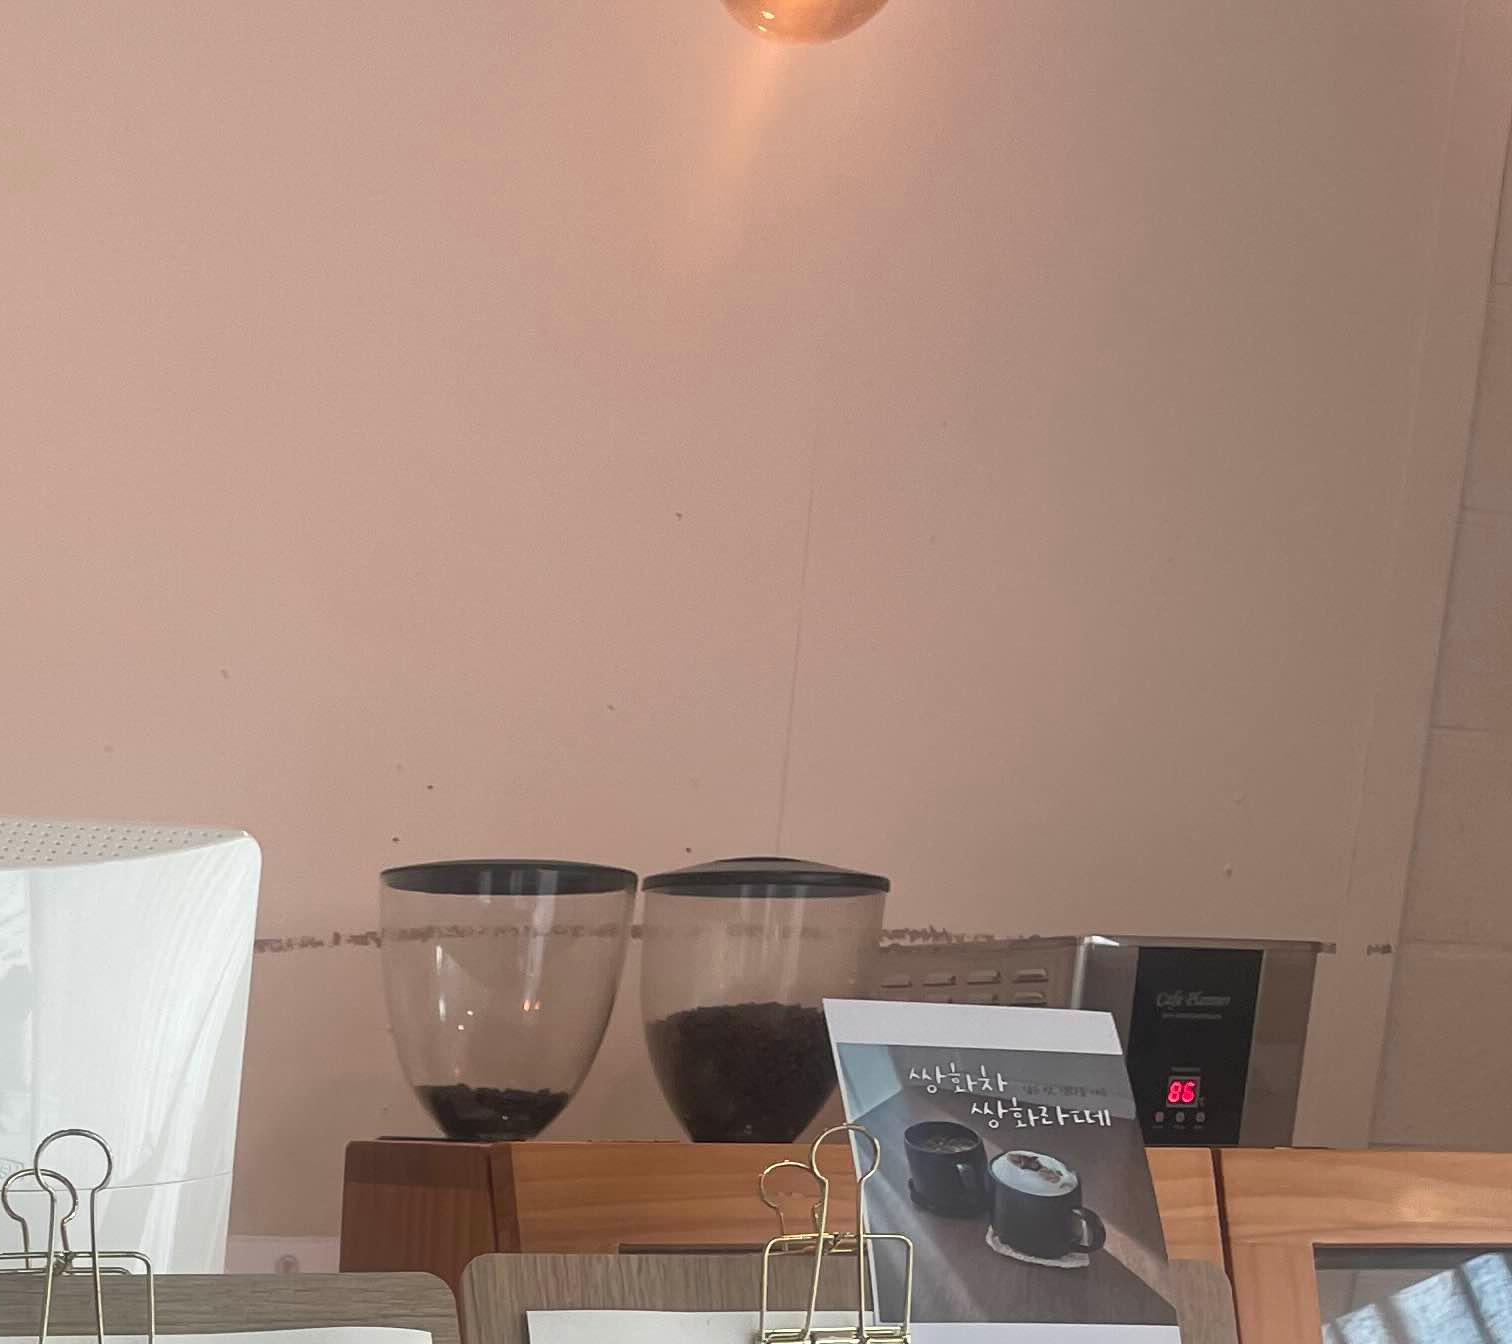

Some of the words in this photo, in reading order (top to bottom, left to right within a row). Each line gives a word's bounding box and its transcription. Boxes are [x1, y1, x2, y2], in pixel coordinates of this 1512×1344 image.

[909, 1062, 1008, 1094] 쌍화차
[1168, 1081, 1196, 1102] 86
[971, 1097, 1112, 1129] 쌍화라떼
